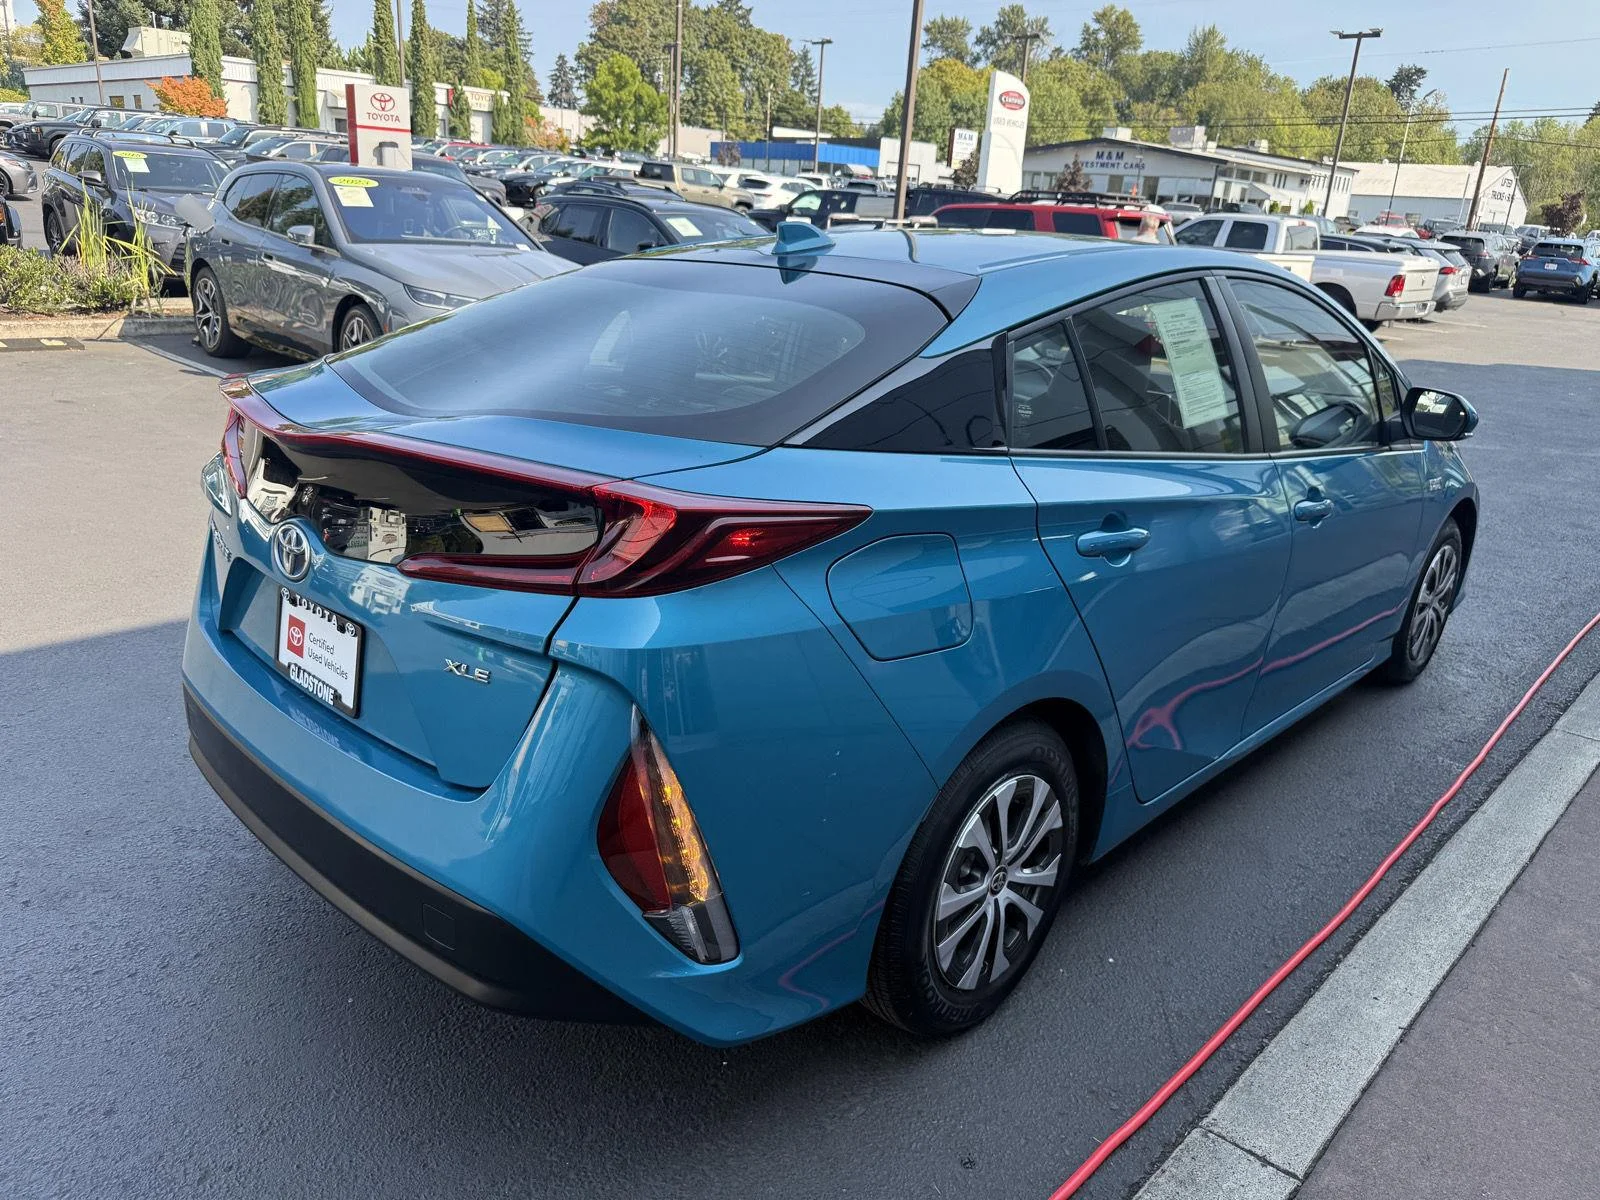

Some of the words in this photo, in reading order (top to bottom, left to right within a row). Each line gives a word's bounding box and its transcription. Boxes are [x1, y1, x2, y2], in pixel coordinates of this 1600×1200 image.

[366, 112, 400, 123] TOYOTA
[1123, 162, 1146, 170] CARS
[295, 593, 338, 626] TOYOTA
[308, 632, 335, 655] Certified
[307, 647, 323, 664] Used
[323, 656, 349, 680] Vehicles
[443, 658, 490, 683] XLE
[289, 663, 335, 706] GLADSTONE
